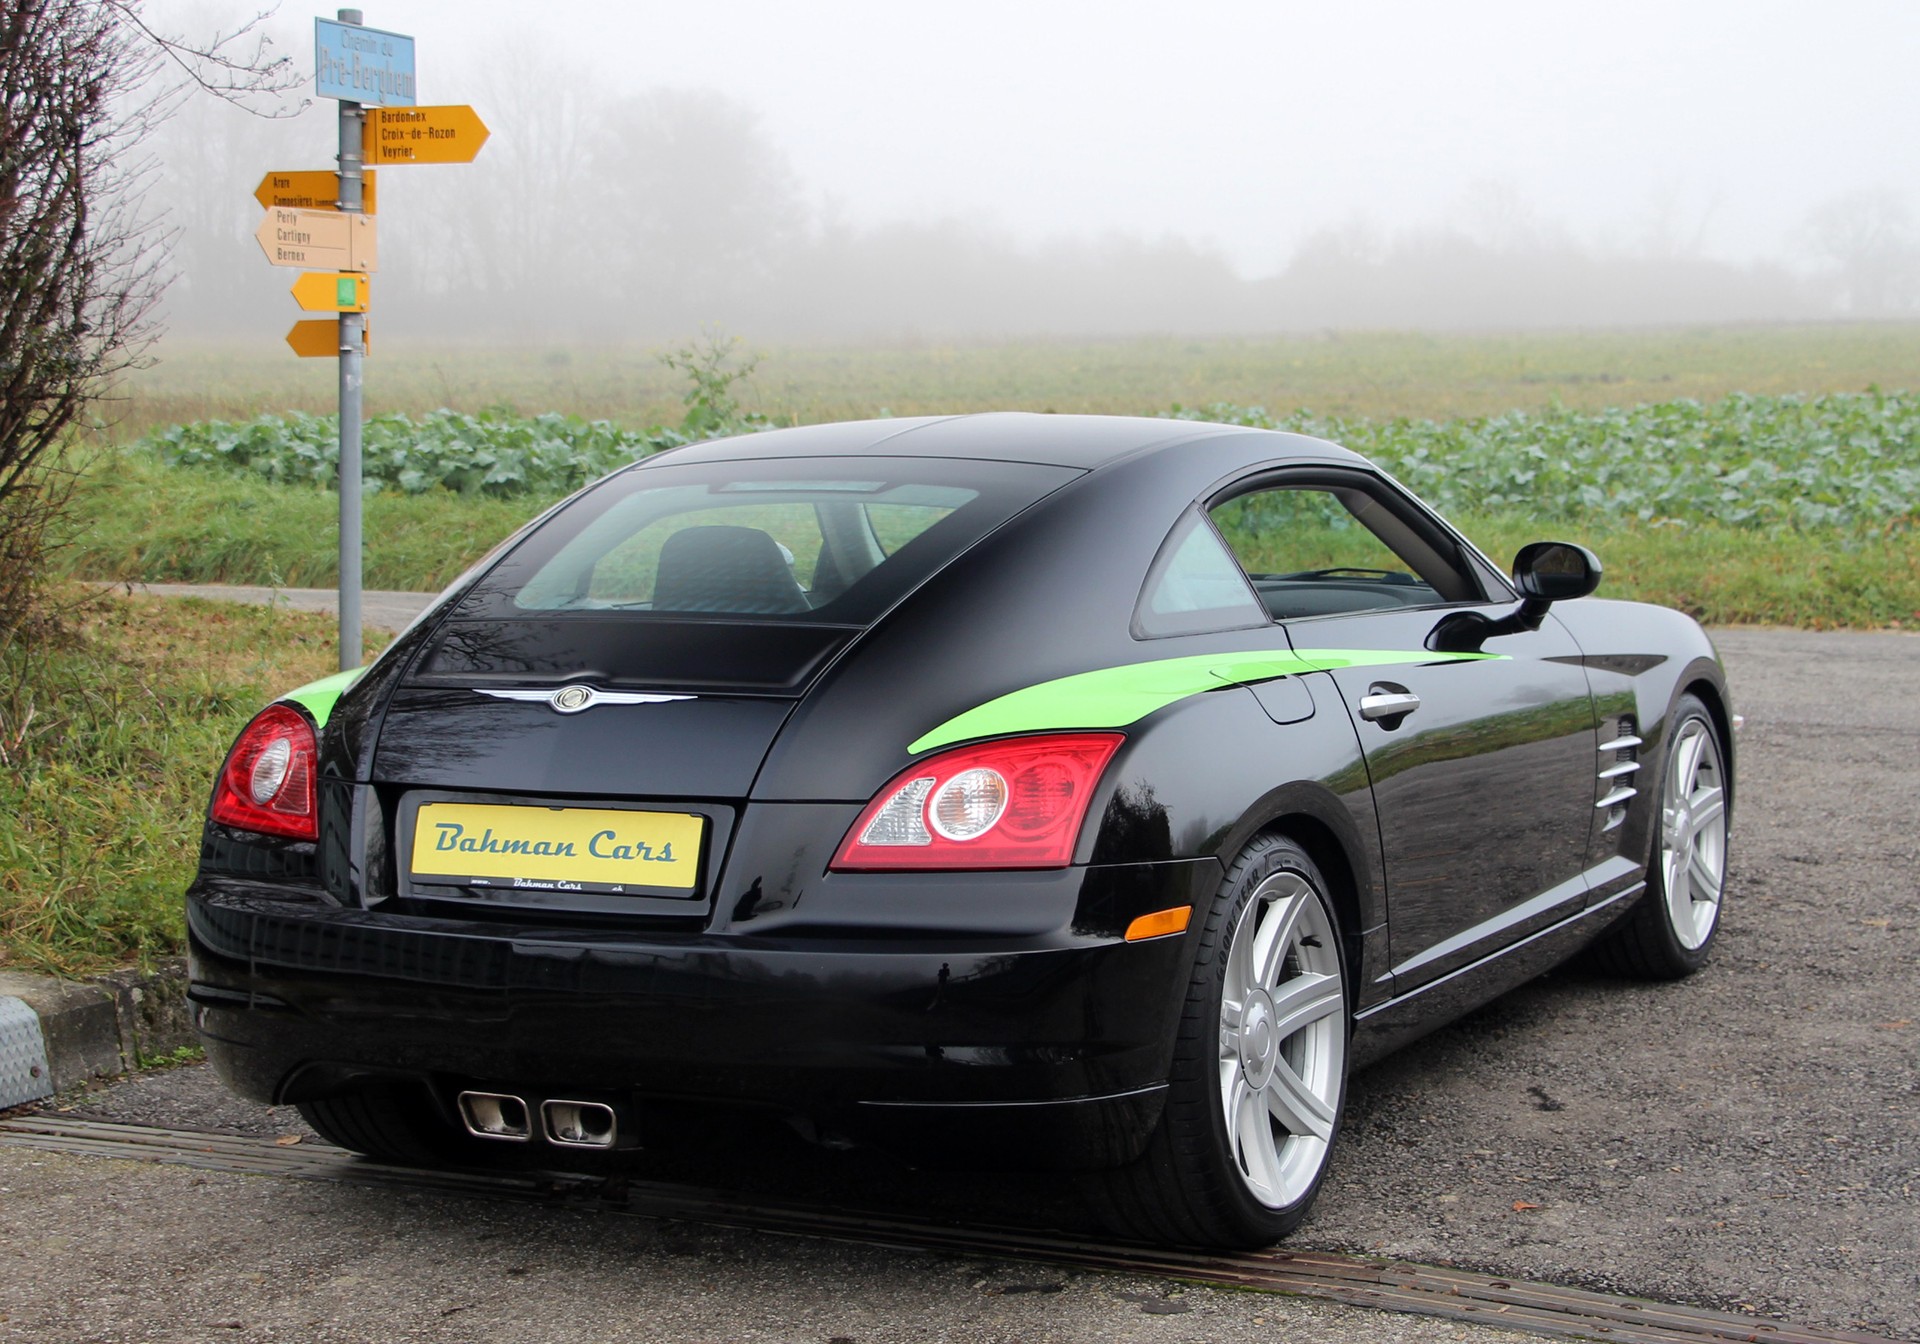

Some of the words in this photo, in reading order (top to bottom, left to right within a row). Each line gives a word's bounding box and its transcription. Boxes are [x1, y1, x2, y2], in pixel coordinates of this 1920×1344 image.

[381, 111, 427, 124] Bardonnex
[382, 126, 456, 141] Croix-de-Rozon
[382, 145, 414, 159] Veyrier
[276, 210, 298, 226] Perly
[276, 227, 311, 244] Cartigny
[276, 247, 306, 262] Bernex
[434, 822, 578, 858] Bahman
[588, 829, 679, 863] Cars
[513, 877, 555, 889] Bahman
[557, 880, 583, 891] Cars
